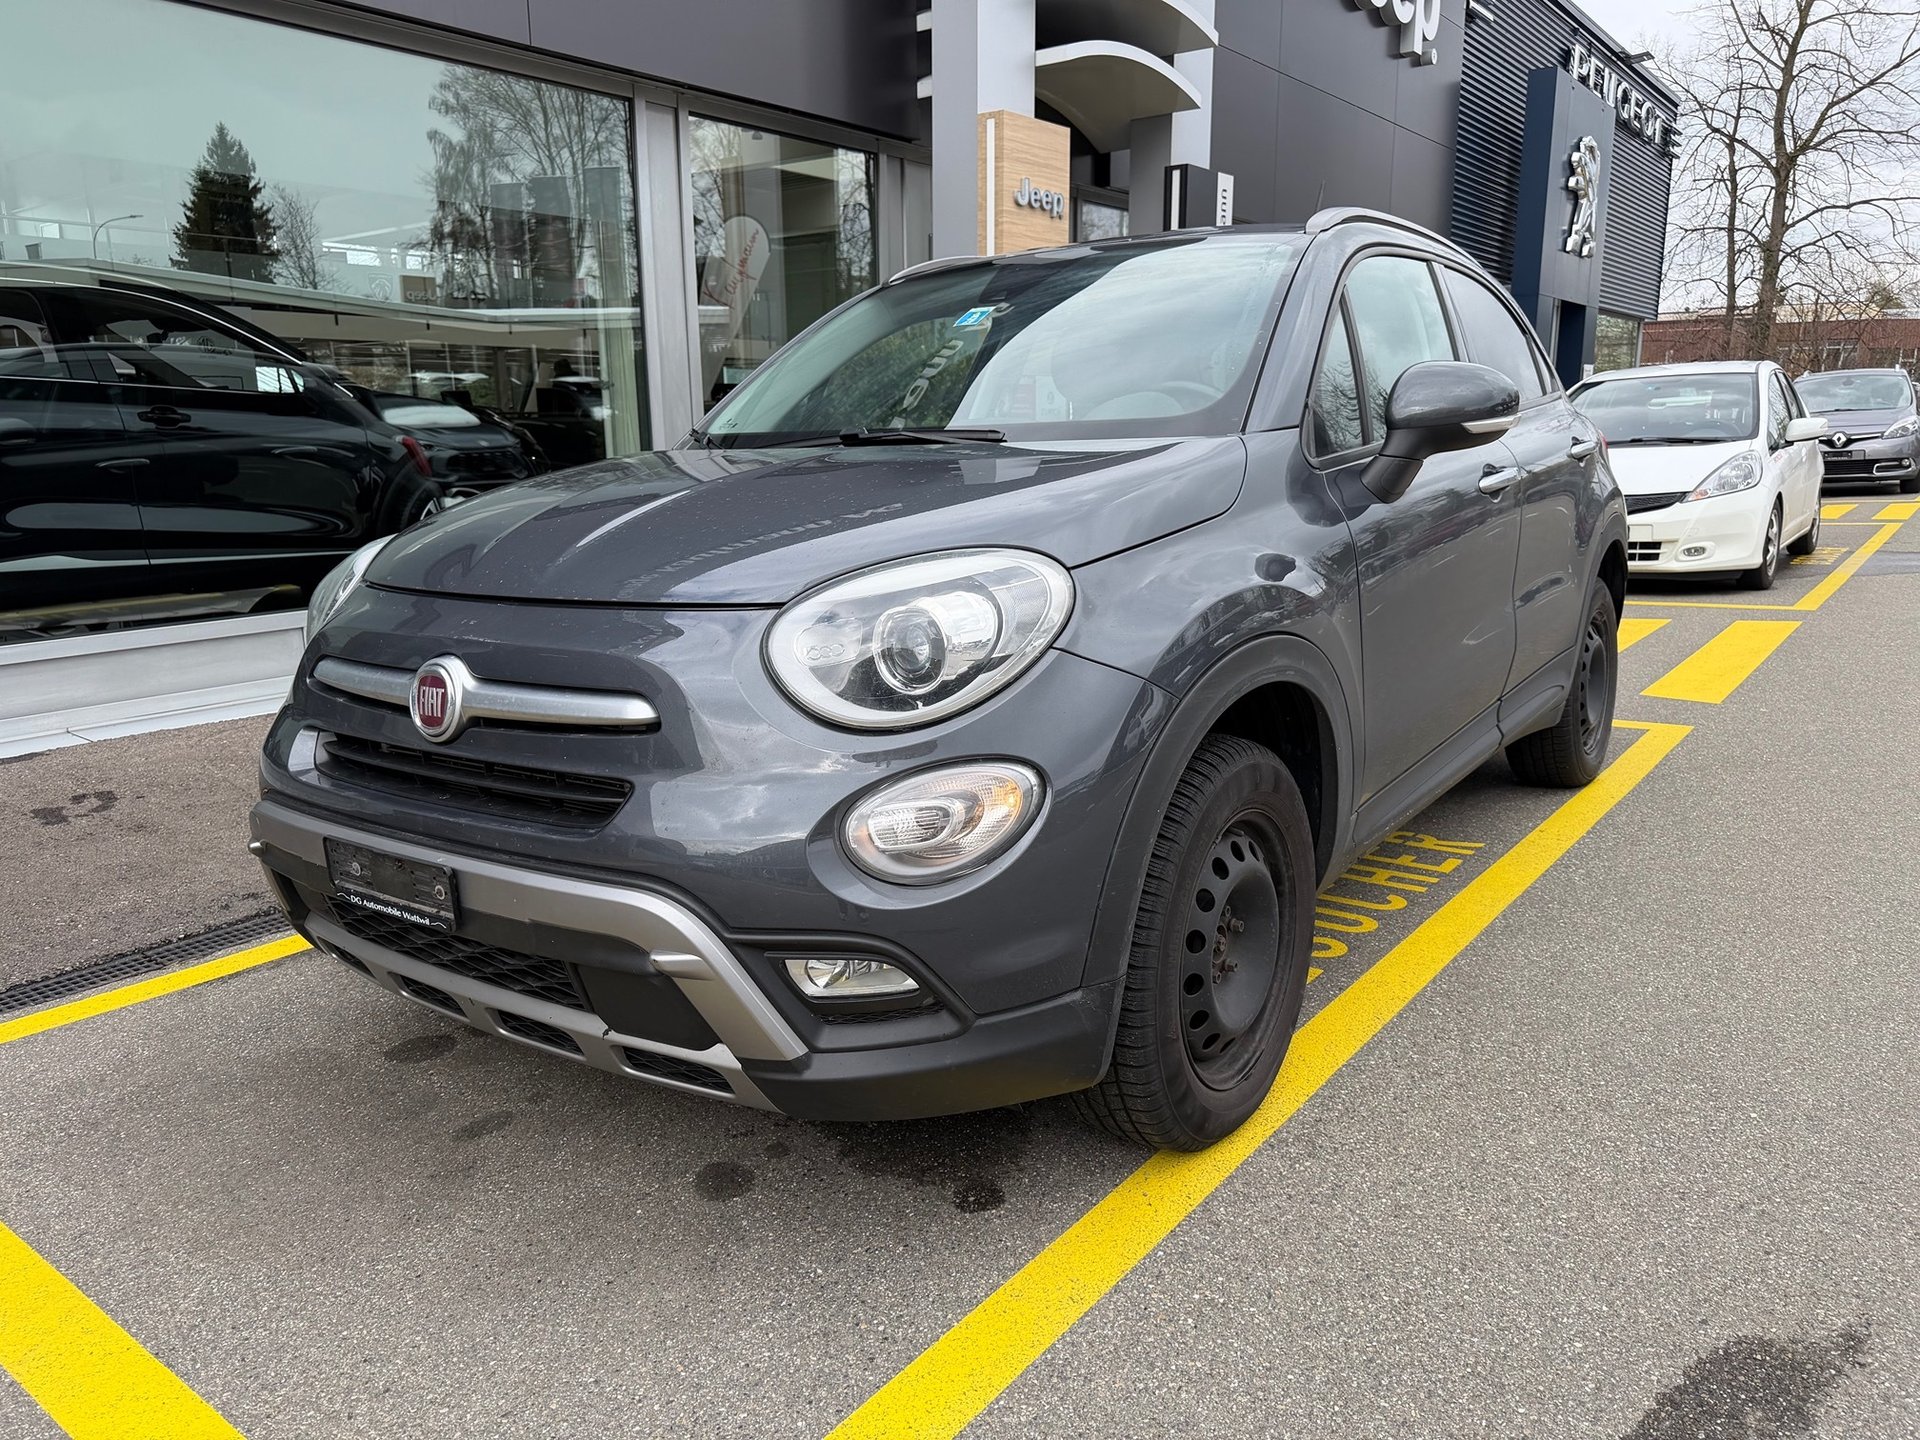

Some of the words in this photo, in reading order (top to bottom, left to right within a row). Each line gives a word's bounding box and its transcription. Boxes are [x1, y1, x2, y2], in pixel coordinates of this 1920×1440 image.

[1570, 44, 1668, 144] PEUGEOT
[1014, 177, 1064, 219] Jeep
[420, 686, 445, 718] FIAT
[350, 895, 362, 905] DG
[363, 899, 402, 917] Automobile
[402, 911, 430, 926] Wattwil
